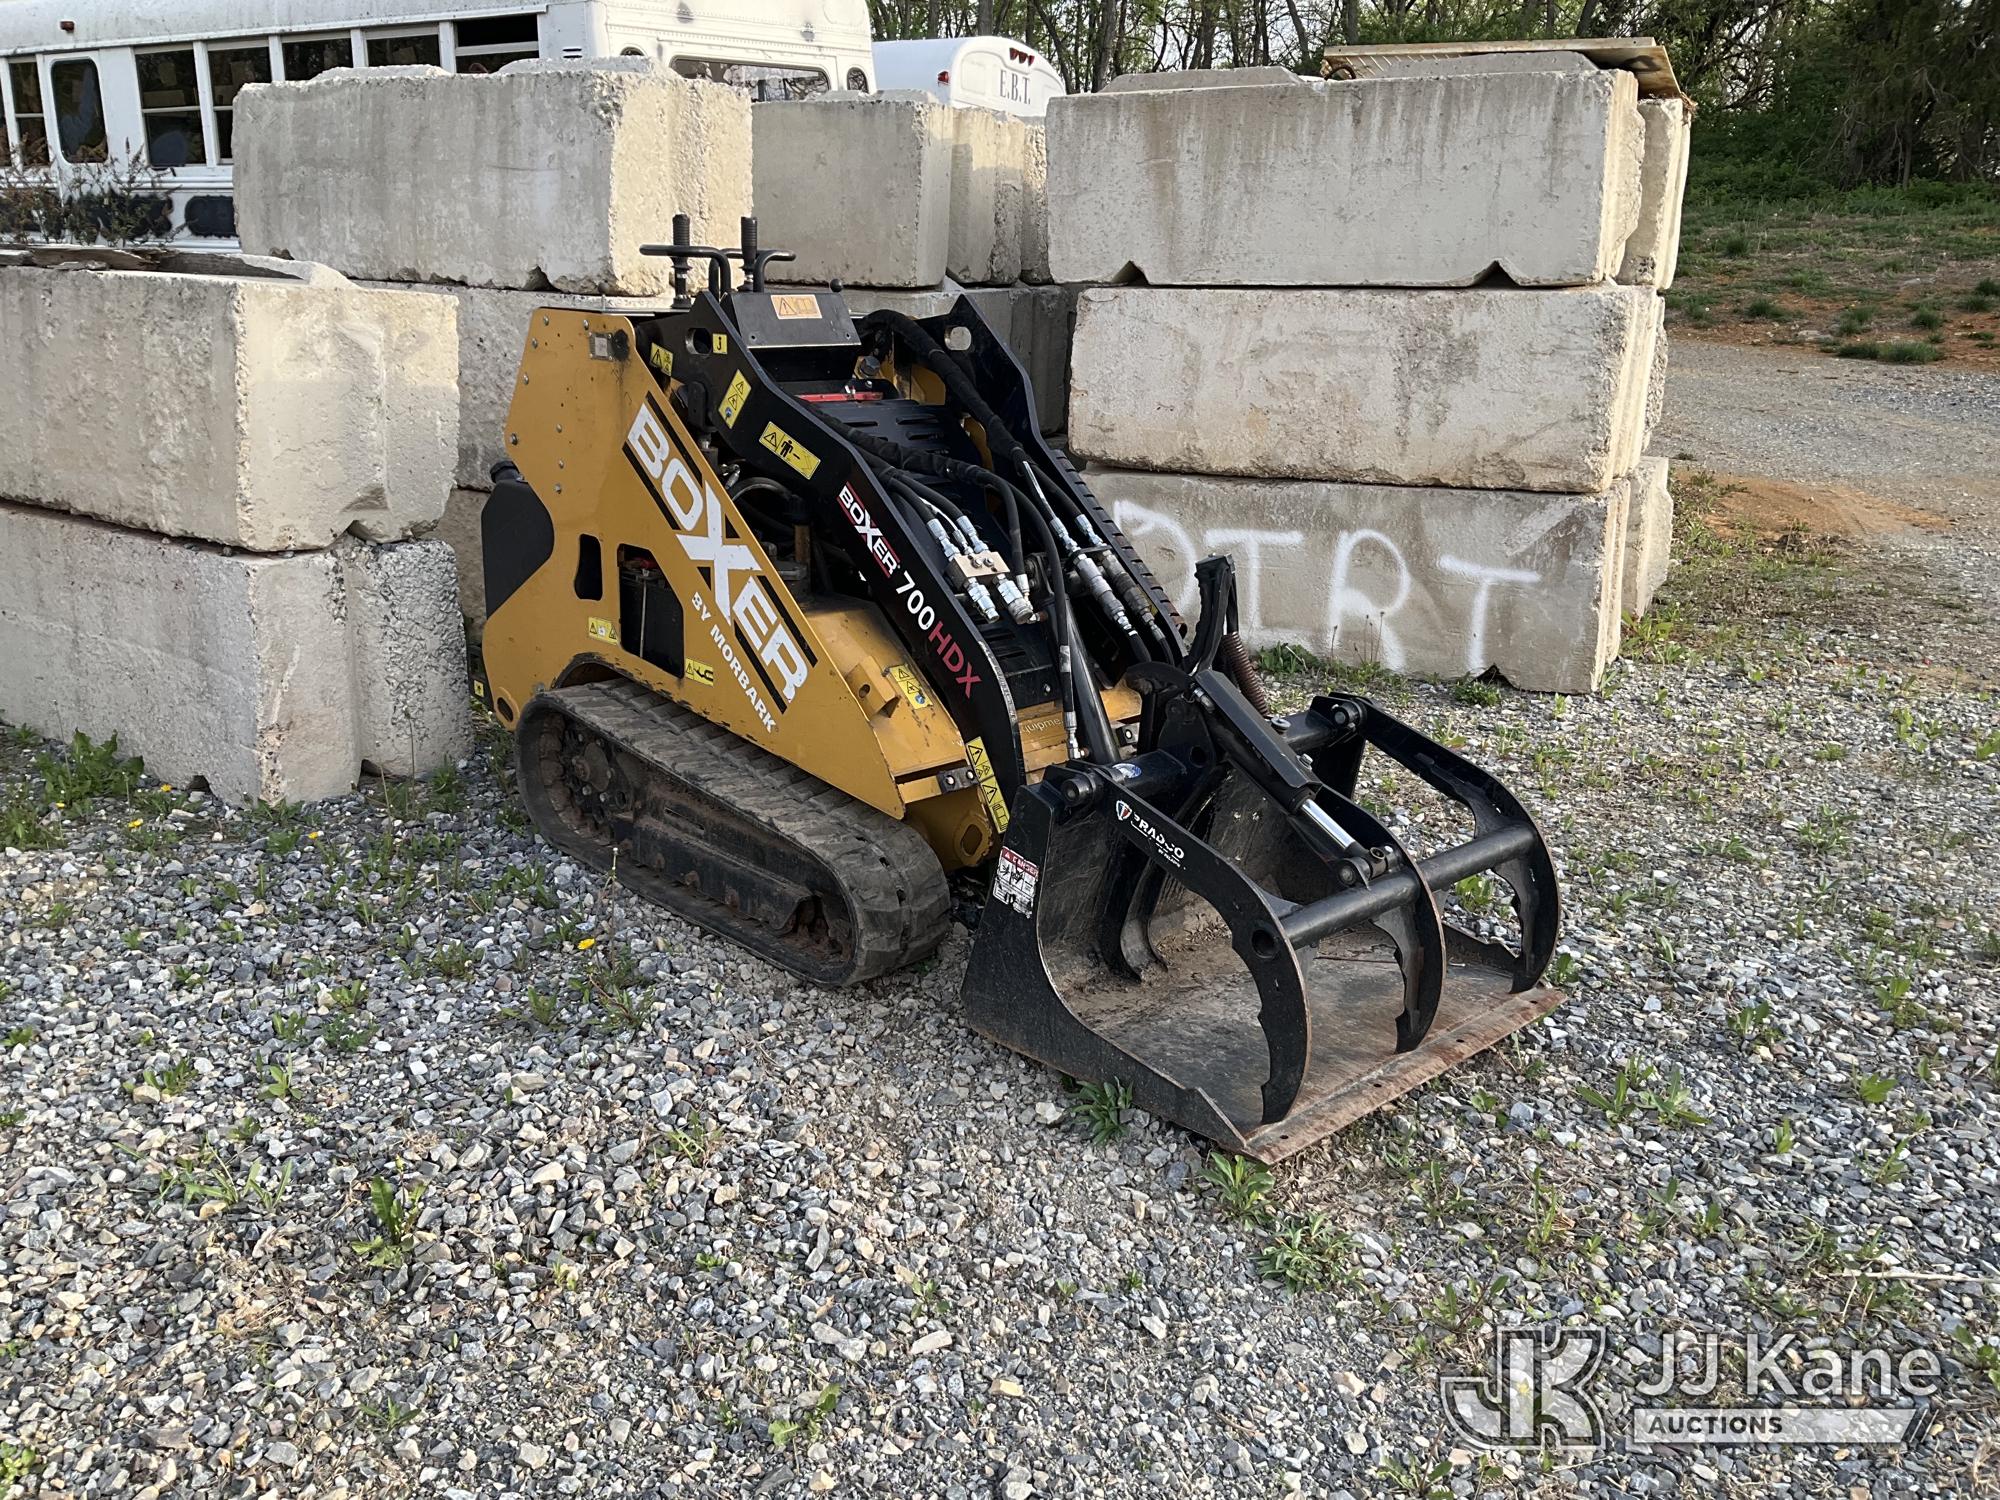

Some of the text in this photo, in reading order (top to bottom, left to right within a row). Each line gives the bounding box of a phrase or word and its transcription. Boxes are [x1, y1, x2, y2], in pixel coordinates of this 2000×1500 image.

[1000, 68, 1032, 105] E.B.T.
[627, 402, 809, 703] BOXER
[838, 485, 899, 575] BOXER
[691, 591, 777, 733] BY MORBARK
